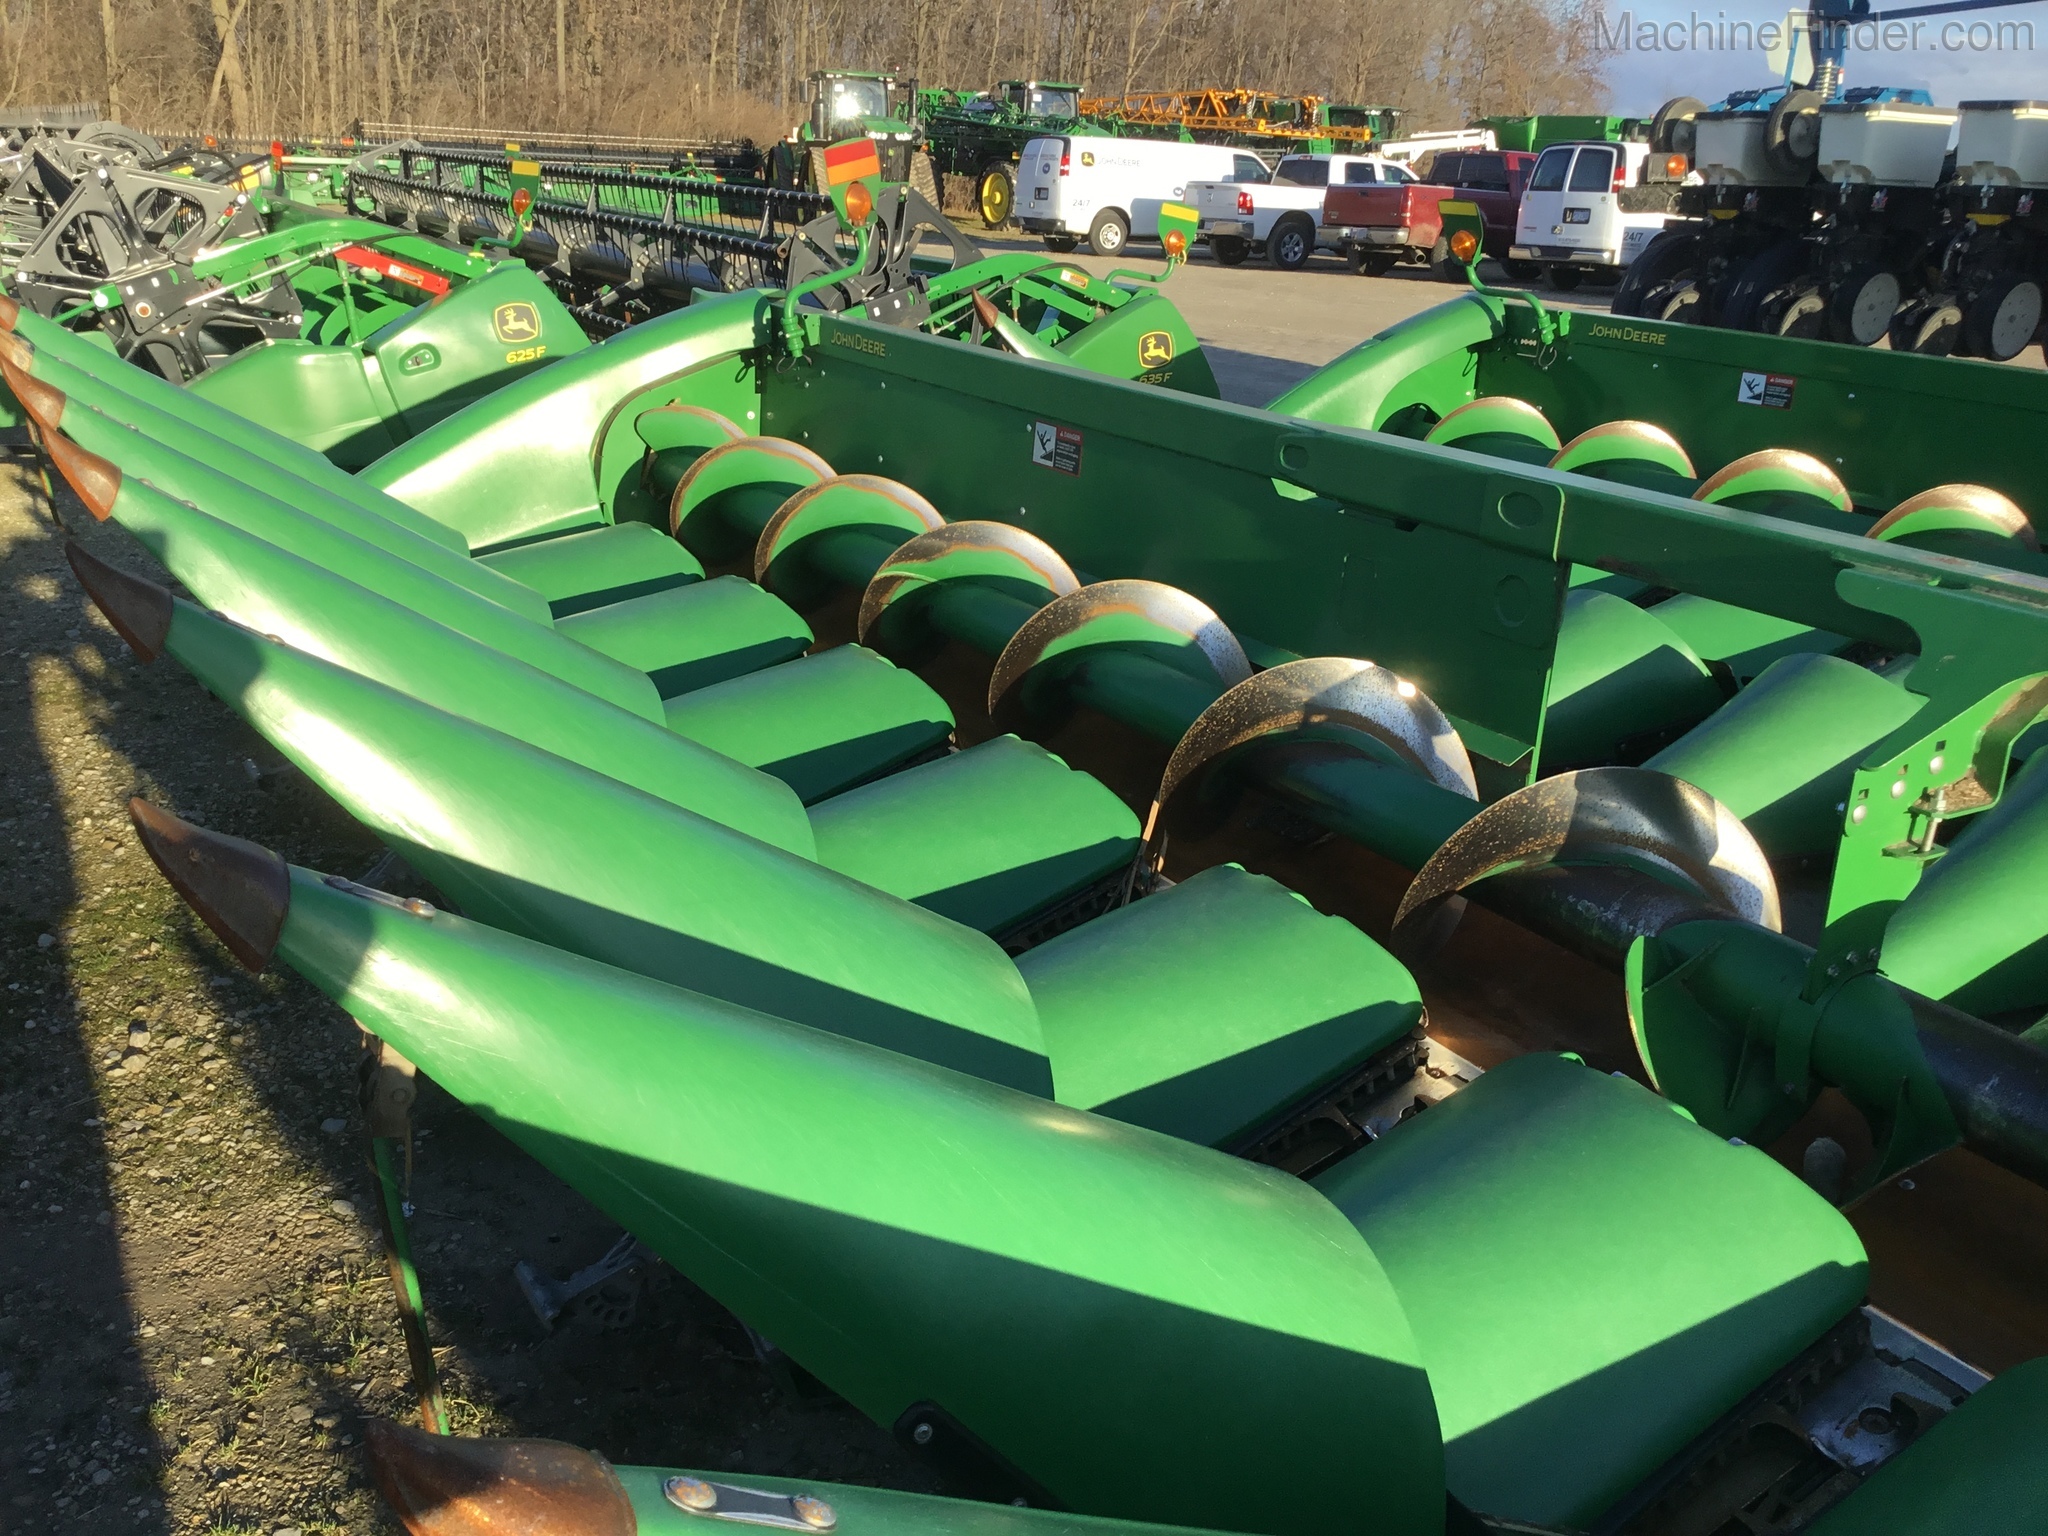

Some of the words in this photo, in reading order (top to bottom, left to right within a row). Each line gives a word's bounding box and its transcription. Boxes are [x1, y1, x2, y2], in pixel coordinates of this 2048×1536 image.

[1117, 157, 1141, 168] DEERE
[1623, 231, 1644, 242] 24/7
[830, 328, 855, 349] JOHN
[854, 333, 886, 357] DEERE
[1588, 323, 1622, 339] JOHN
[1623, 327, 1667, 346] DEERE
